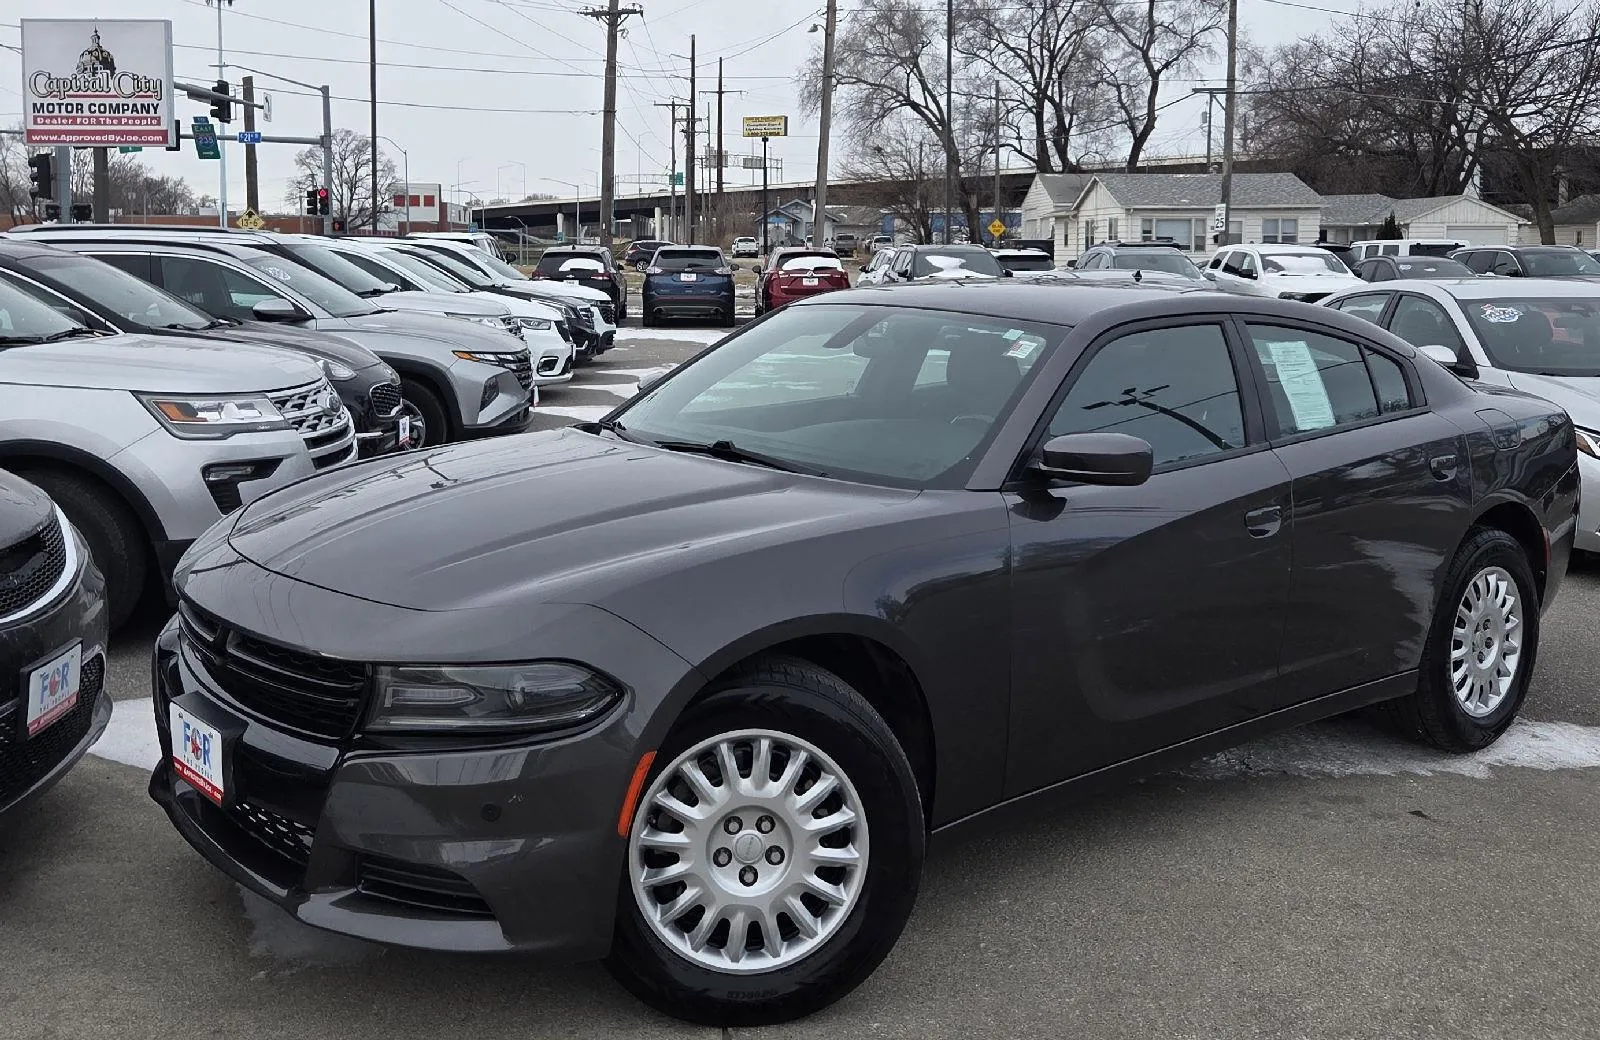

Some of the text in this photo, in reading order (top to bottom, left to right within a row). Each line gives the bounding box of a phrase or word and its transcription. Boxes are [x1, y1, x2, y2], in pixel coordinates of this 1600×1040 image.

[29, 70, 162, 100] Capital City
[32, 102, 160, 115] MOTOR COMPANY
[37, 117, 158, 126] Dealer FOR The People
[31, 133, 163, 142] www.ApprovedByJoe.com
[241, 218, 258, 227] 13-6
[1215, 217, 1225, 229] 25
[183, 720, 212, 770] FOR
